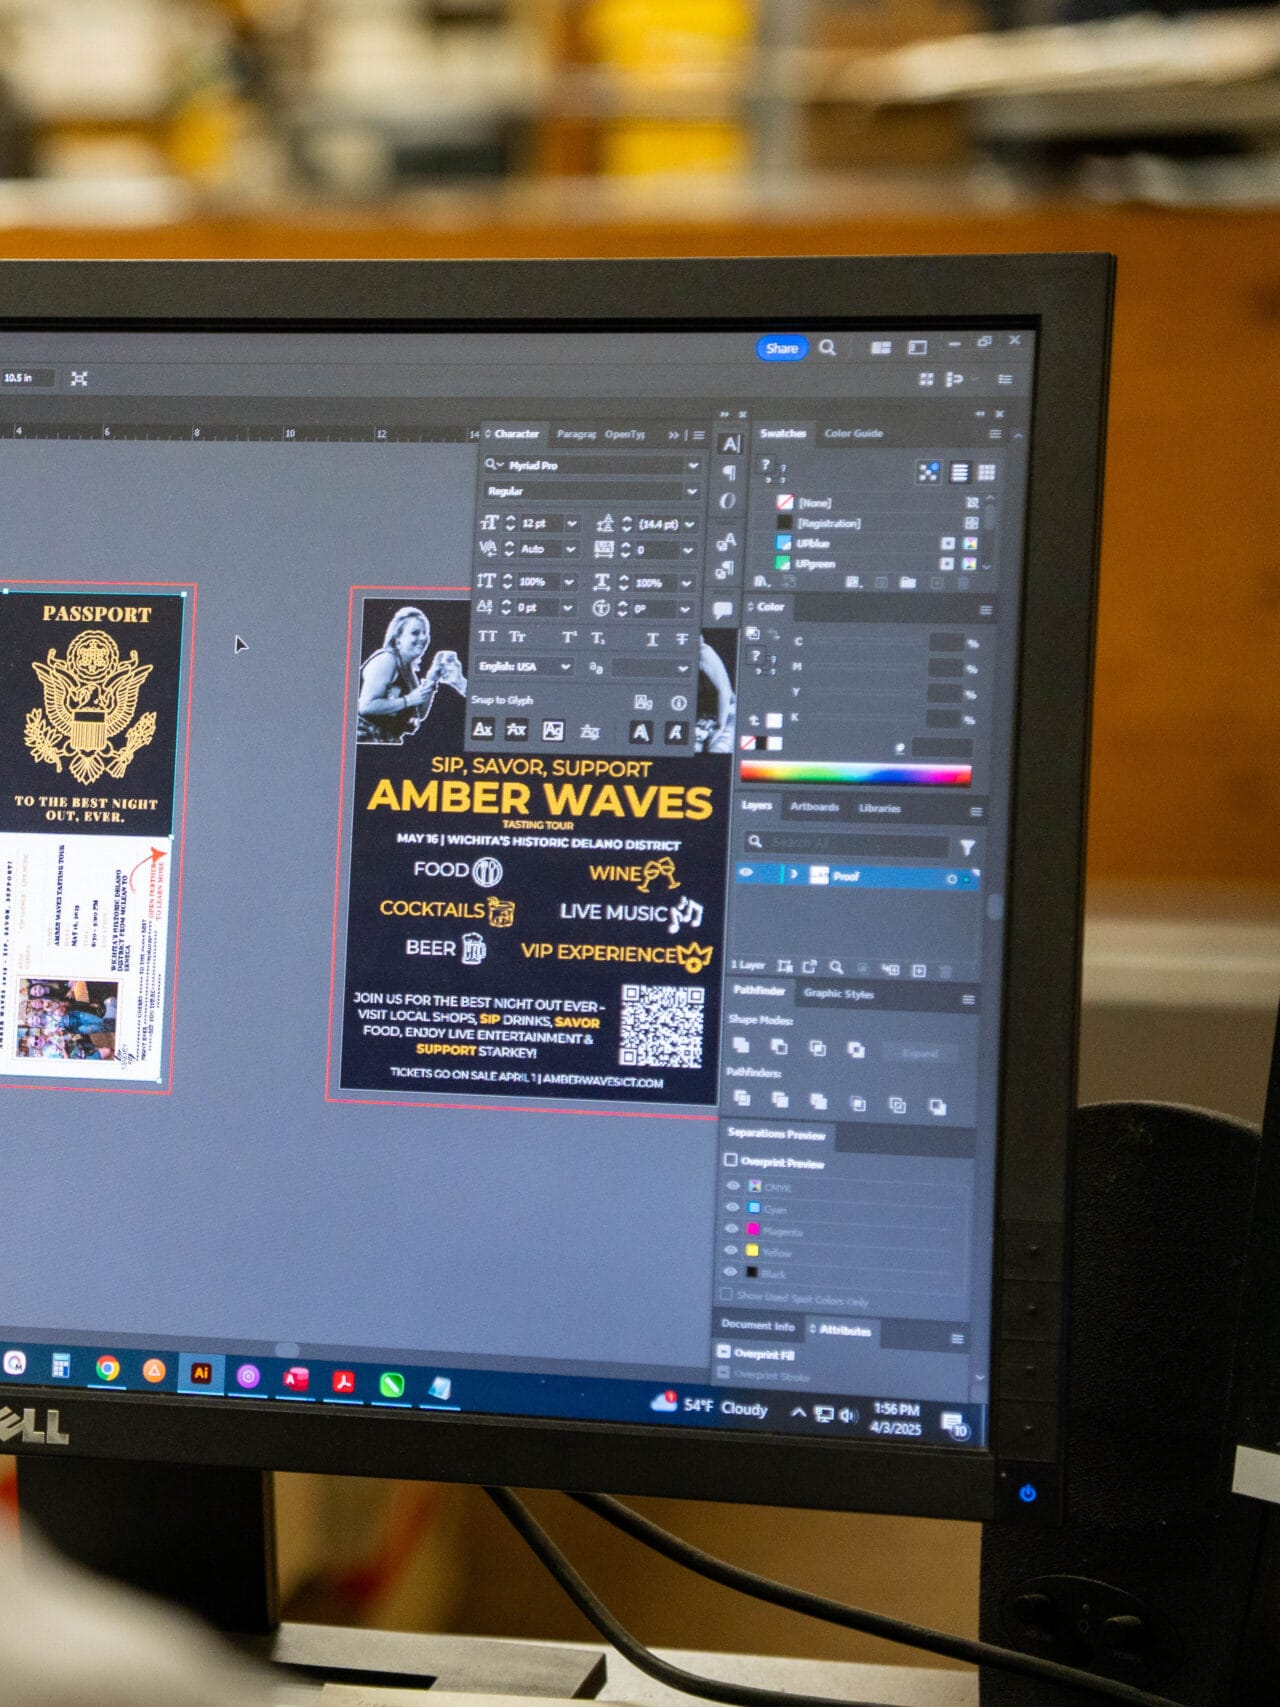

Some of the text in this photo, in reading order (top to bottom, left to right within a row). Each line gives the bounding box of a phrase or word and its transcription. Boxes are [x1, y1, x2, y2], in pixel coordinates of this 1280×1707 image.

[766, 342, 799, 354] Share
[495, 429, 540, 439] Character
[760, 428, 807, 438] Swatches
[824, 428, 883, 438] Color Guide
[509, 461, 558, 472] Myriad Pro
[488, 486, 523, 498] Regular
[42, 605, 152, 623] PASSPORT
[757, 602, 785, 612] Color
[431, 756, 654, 778] SIP, SAVOR, SUPPORT
[15, 796, 158, 811] TO THE BEST NIGHT
[366, 778, 714, 821] AMBER WAVES
[742, 801, 772, 812] Layers
[791, 802, 840, 812] Artboards
[859, 803, 901, 814] Libraries
[46, 810, 125, 824] OUT, EVER.
[502, 820, 574, 831] TASTING TOUR
[397, 833, 682, 852] MAY 16 WICHITA'S HISTORIC DELANO DISTRICT
[414, 862, 470, 878] FOOD
[589, 864, 641, 882] WINE
[833, 872, 860, 882] Proof
[379, 900, 486, 920] COCKTAILS
[560, 903, 669, 923] LIVE MUSIC
[406, 940, 456, 957] BEER
[521, 942, 677, 964] VIP EXPERIENCE
[733, 985, 786, 997] Pathfinder
[353, 992, 595, 1012] JOIN US FOR THE BEST NIGHT OUT EVER
[358, 1008, 600, 1029] VISIT LOCAL SHOPS, SIP DRINKS, SAVOR
[363, 1024, 594, 1045] FOOD, ENJOY LIVE ENTERTAINMENT &
[416, 1042, 537, 1060] SUPPORT STARKEY!
[390, 1066, 433, 1080] TICKETS
[434, 1069, 451, 1080] GO
[452, 1070, 469, 1081] ON
[470, 1070, 498, 1082] SALE
[498, 1071, 530, 1084] APRIL
[543, 1073, 664, 1090] AMBERWAVESICT.COM
[728, 1127, 826, 1142] Separations Preview
[741, 1156, 825, 1170] Overprint Preview
[722, 1318, 796, 1332] Document Info
[820, 1324, 872, 1337] Attributes
[683, 1397, 768, 1420] 54°F Cloudy
[874, 1401, 920, 1416] 1:56 PM
[870, 1421, 922, 1437] 4/3/2025
